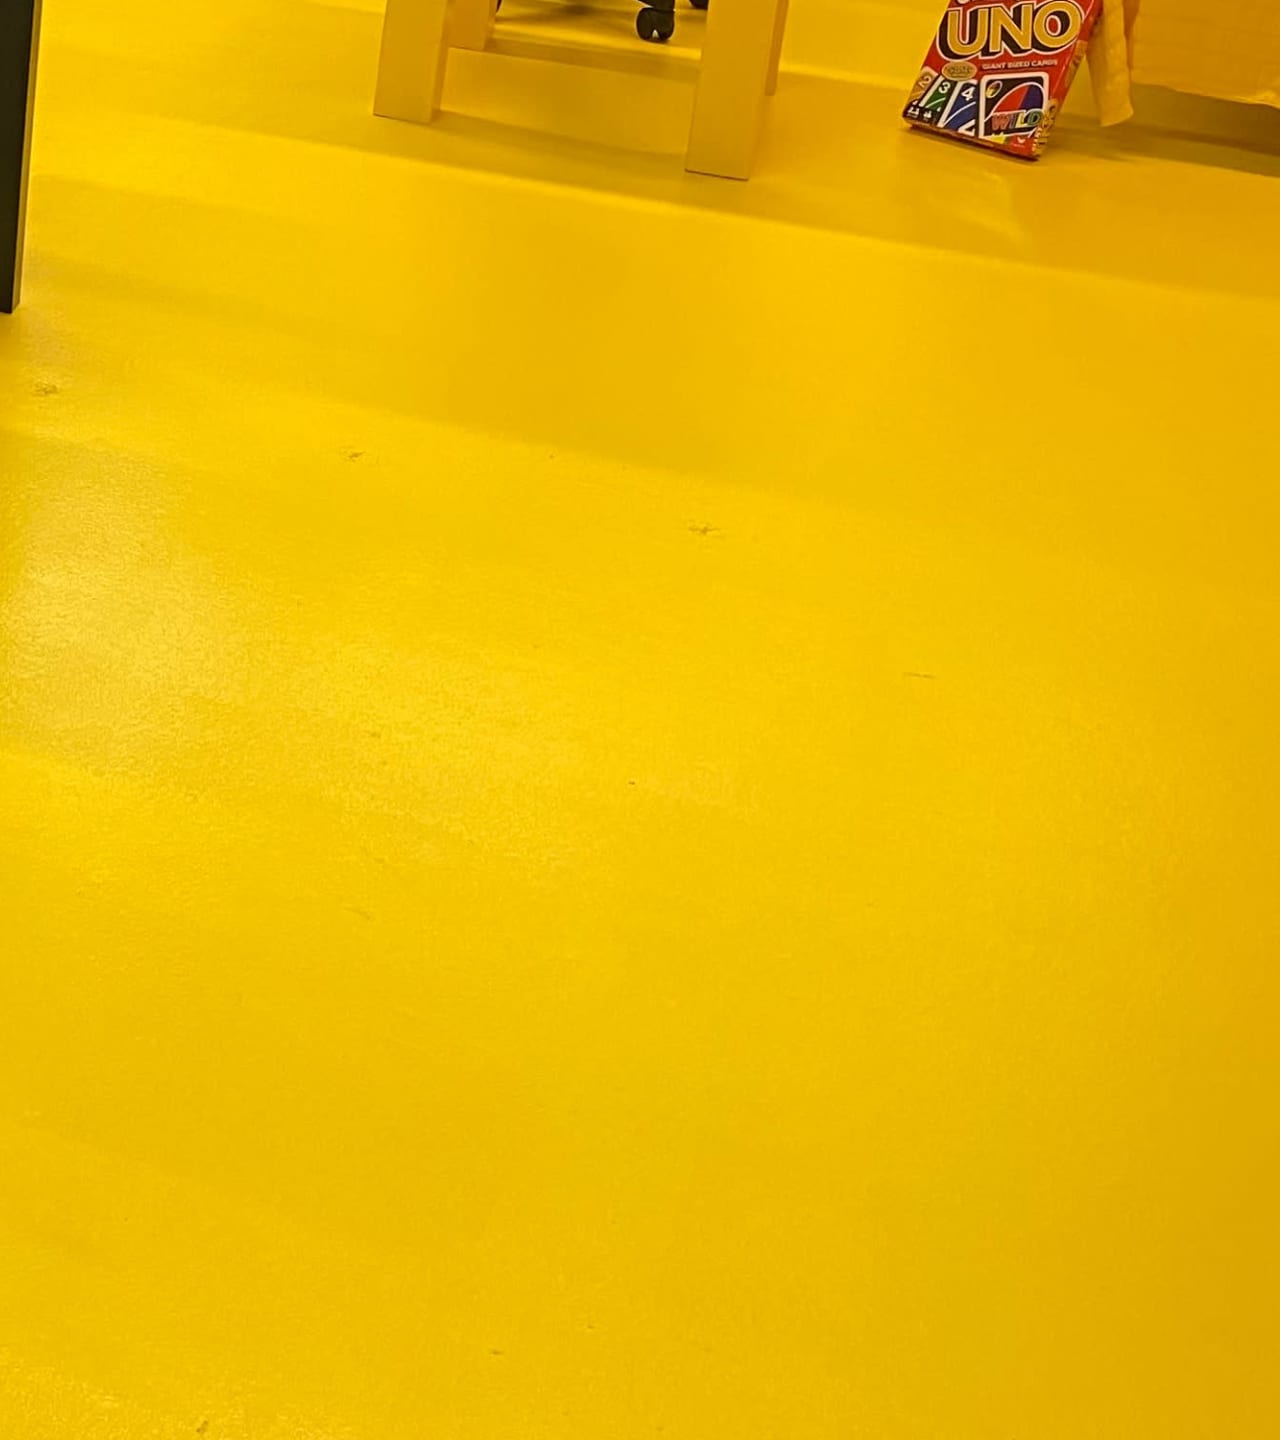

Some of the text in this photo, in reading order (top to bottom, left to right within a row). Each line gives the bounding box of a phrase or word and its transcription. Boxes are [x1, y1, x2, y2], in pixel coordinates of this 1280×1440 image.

[938, 81, 951, 94] 3
[961, 86, 975, 101] 4
[991, 110, 1044, 131] WILD
